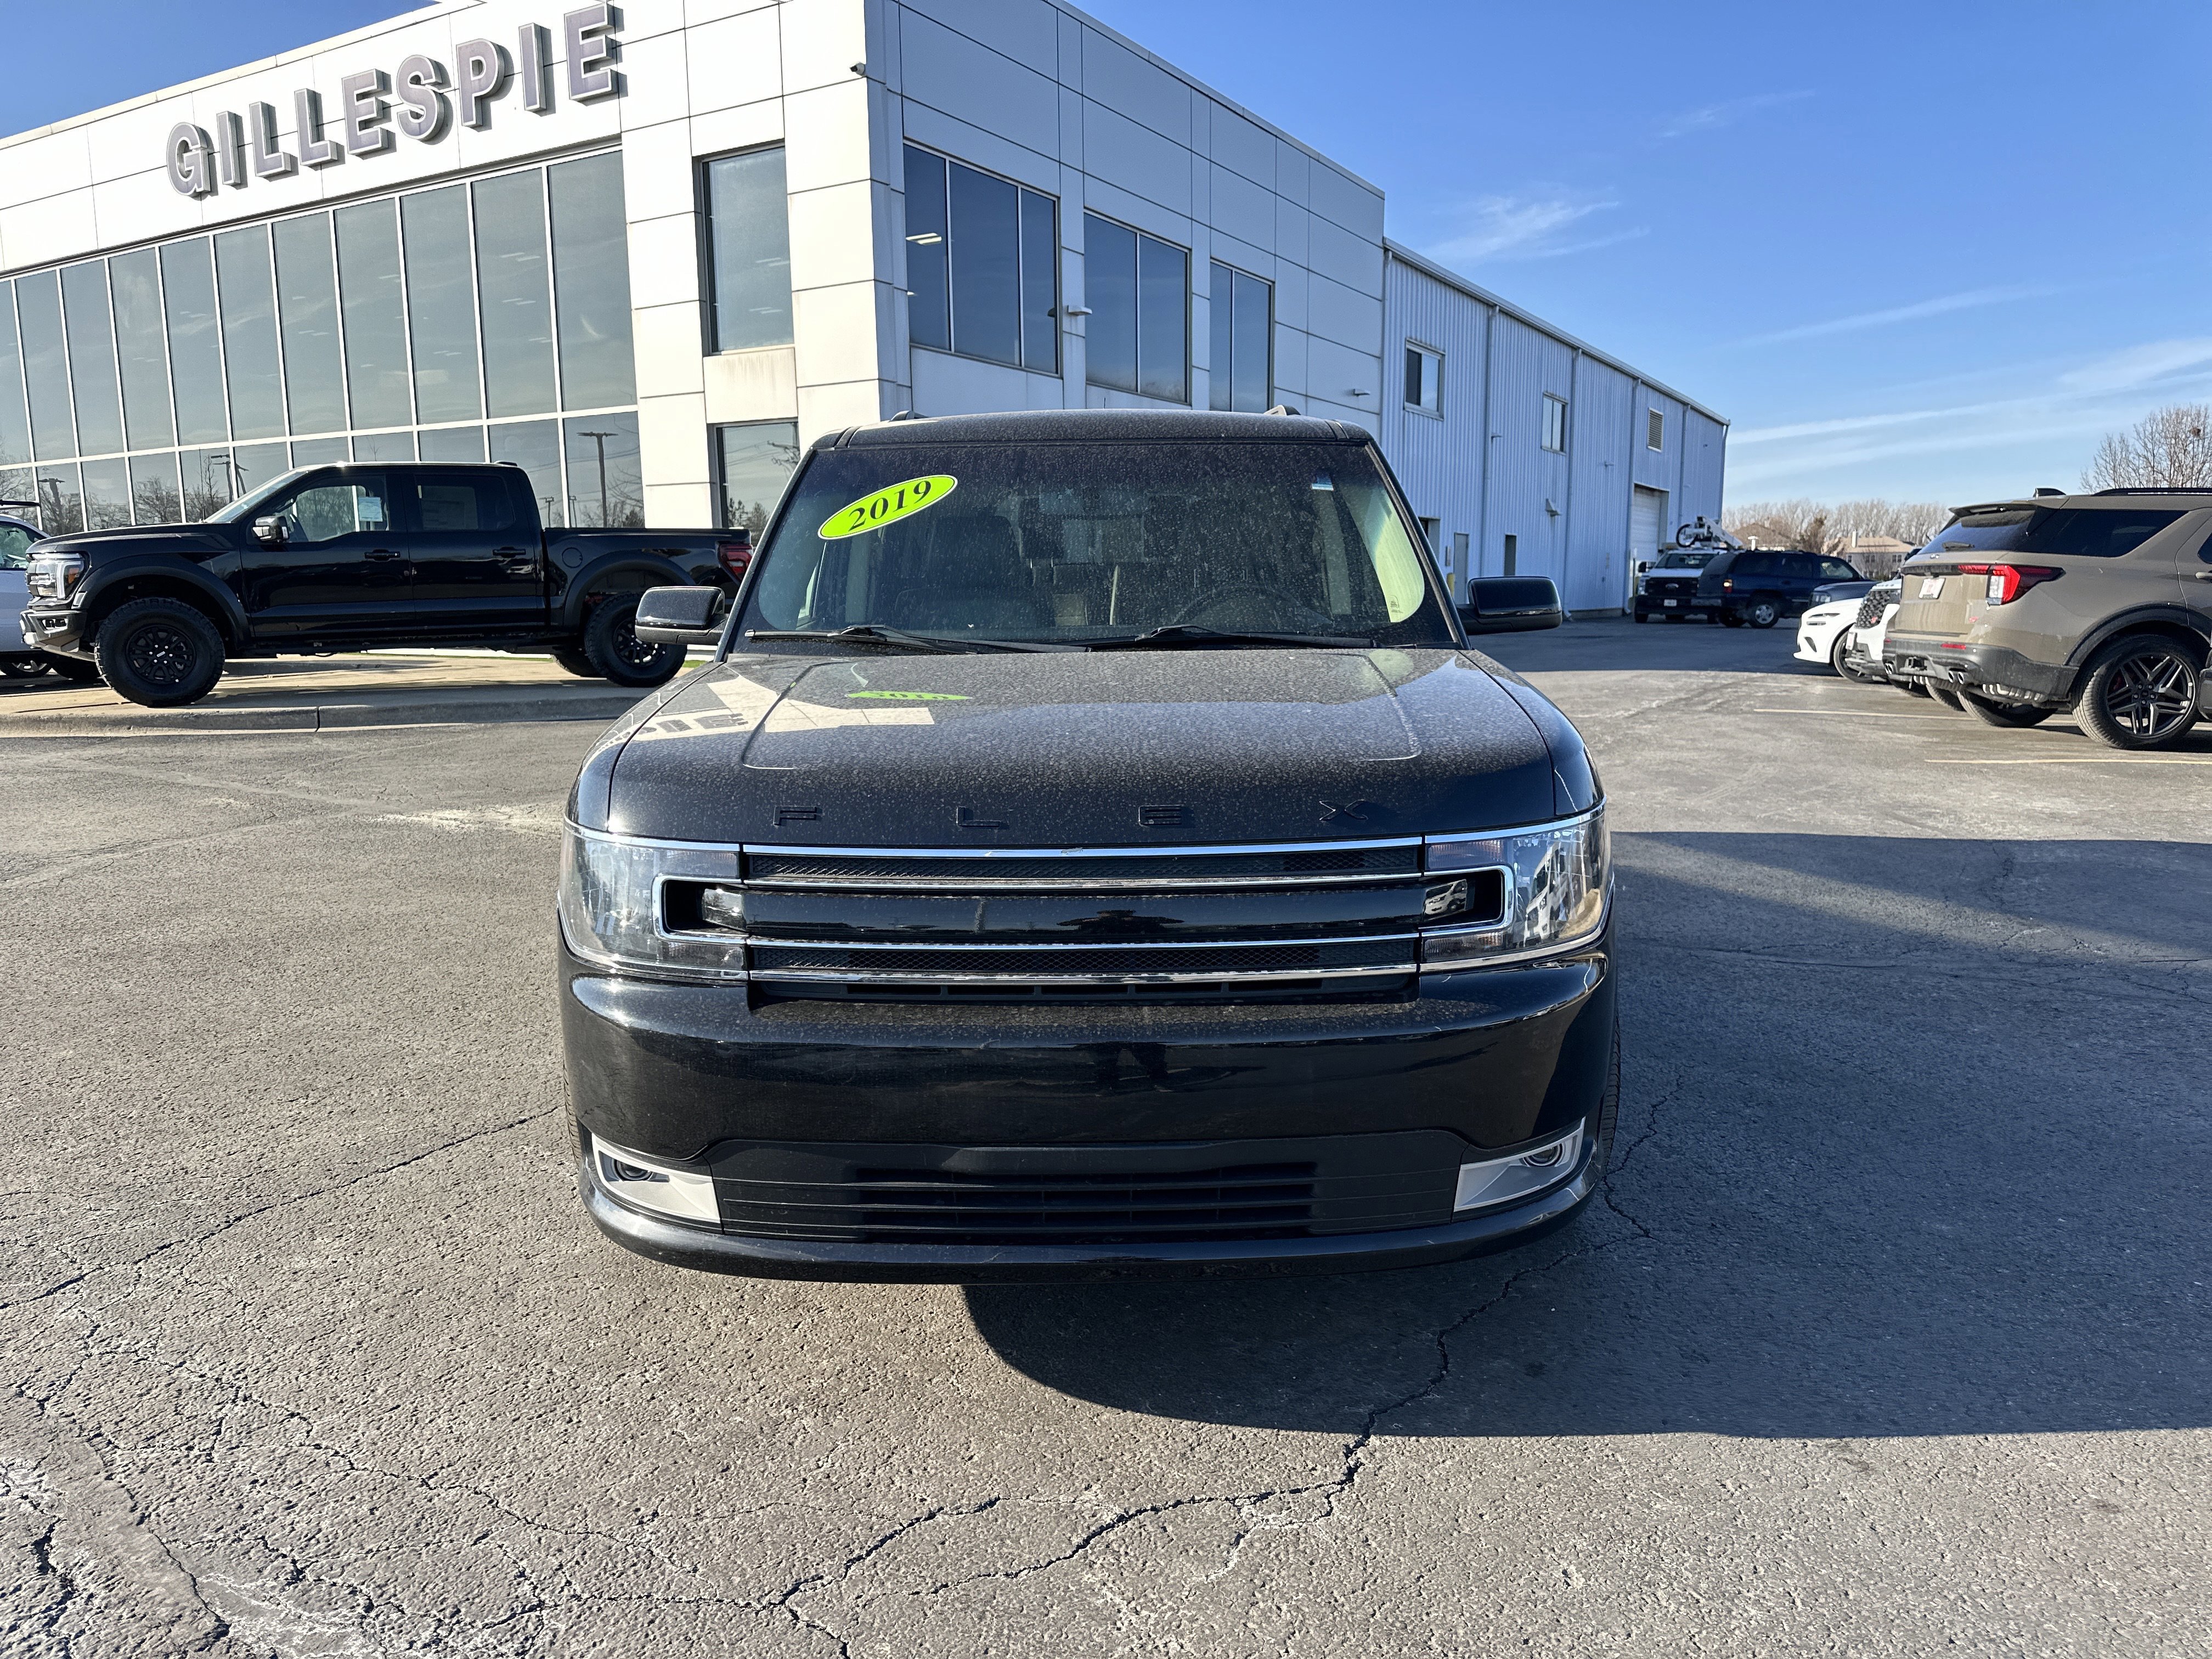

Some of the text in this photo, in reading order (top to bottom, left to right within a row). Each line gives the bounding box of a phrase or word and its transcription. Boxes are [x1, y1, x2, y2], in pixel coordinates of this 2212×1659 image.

[166, 3, 628, 199] GILLESPIE
[848, 480, 932, 532] 2019
[772, 799, 1369, 827] FLEX
